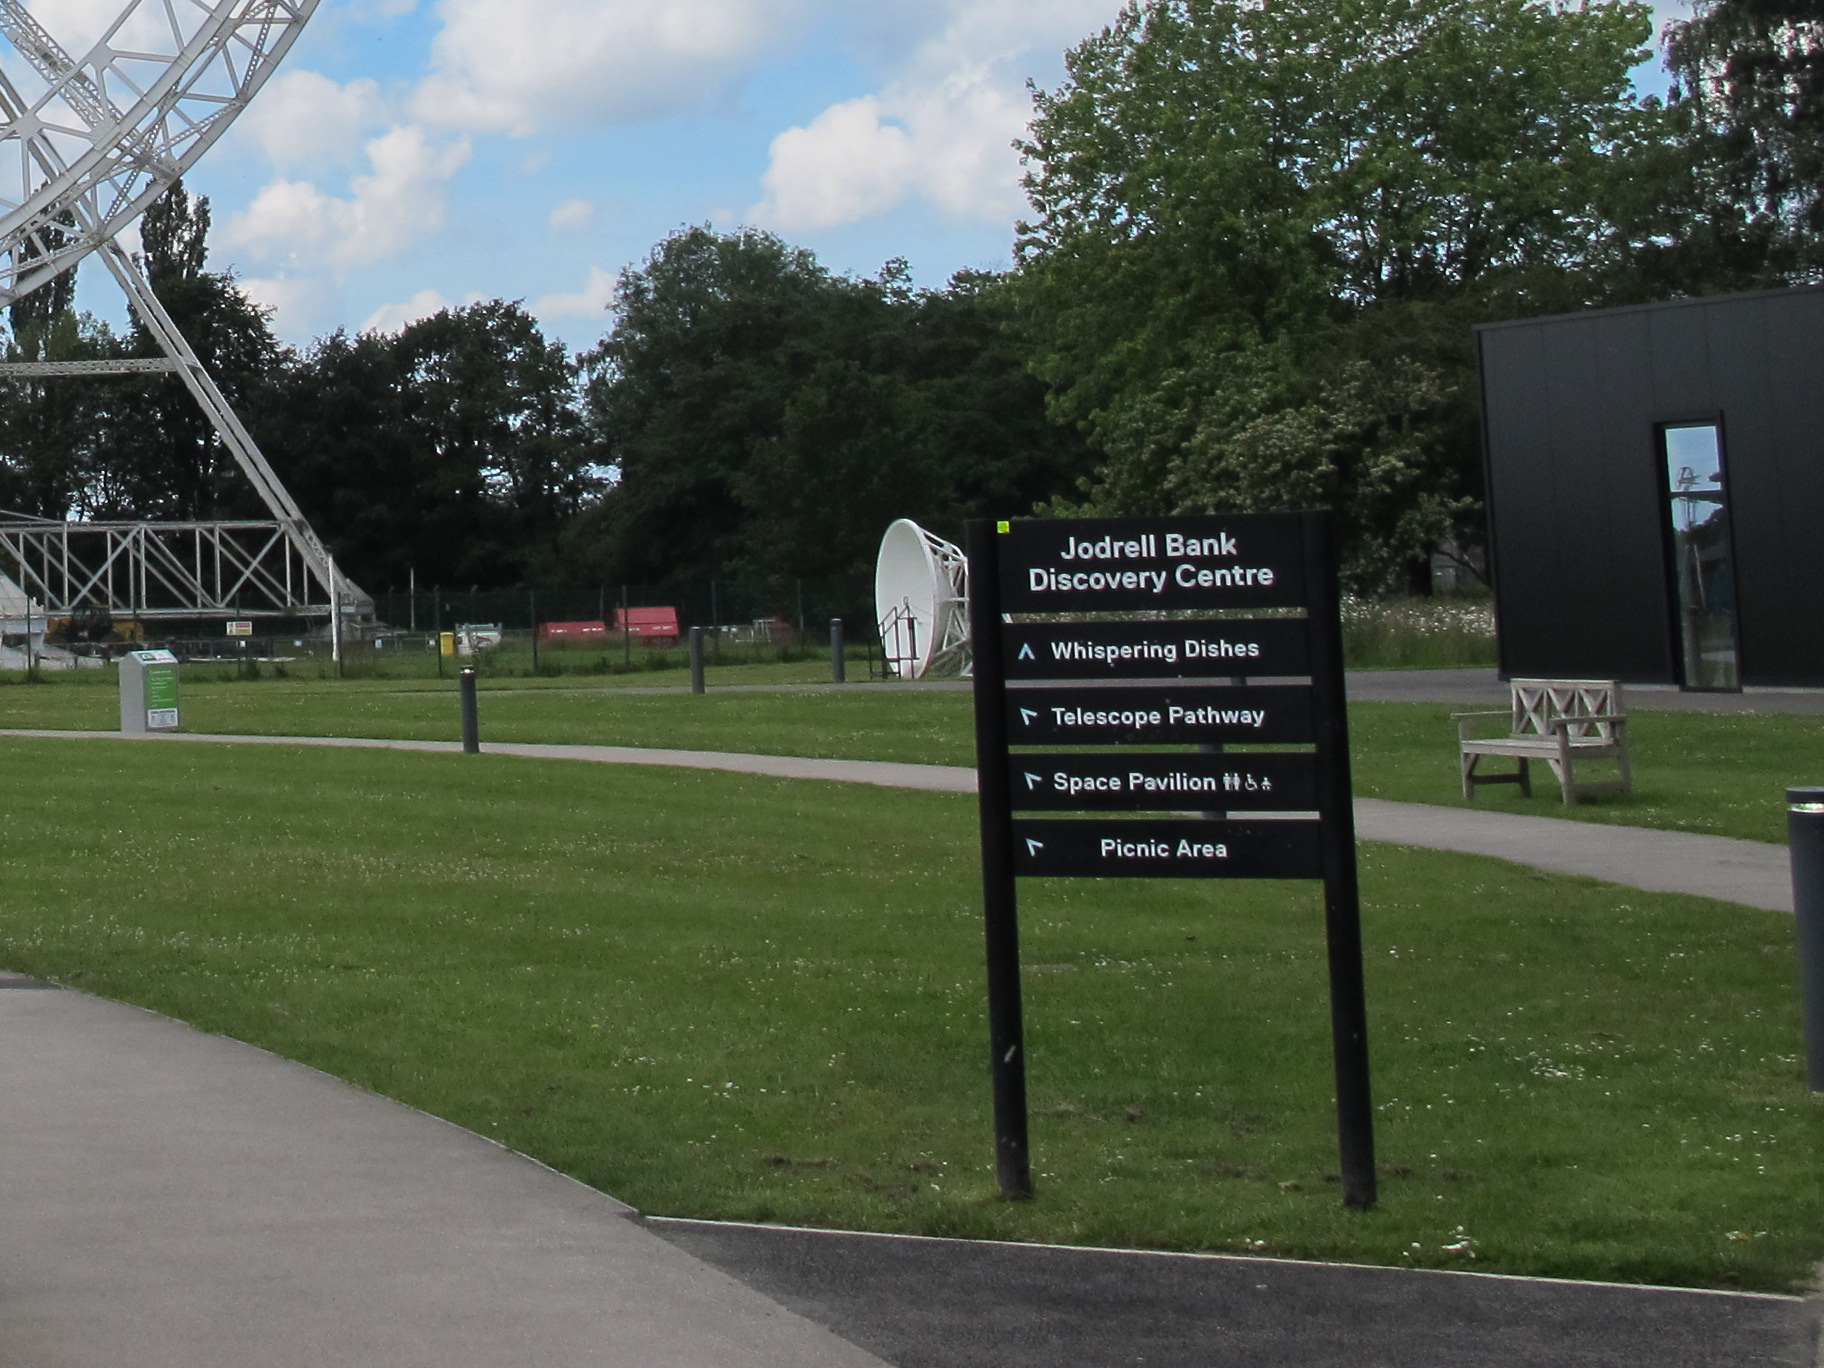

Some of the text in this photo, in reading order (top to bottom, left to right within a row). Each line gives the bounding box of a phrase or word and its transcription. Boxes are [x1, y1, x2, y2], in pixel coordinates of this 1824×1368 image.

[1061, 532, 1236, 559] Jodrell Bank
[1030, 564, 1273, 593] Discovery Centre
[1051, 640, 1259, 663] Whispering Dishes
[1051, 706, 1264, 729] Telescope Pathway
[1054, 773, 1216, 795] Space Pavilion
[1101, 839, 1227, 857] Picnic Area
